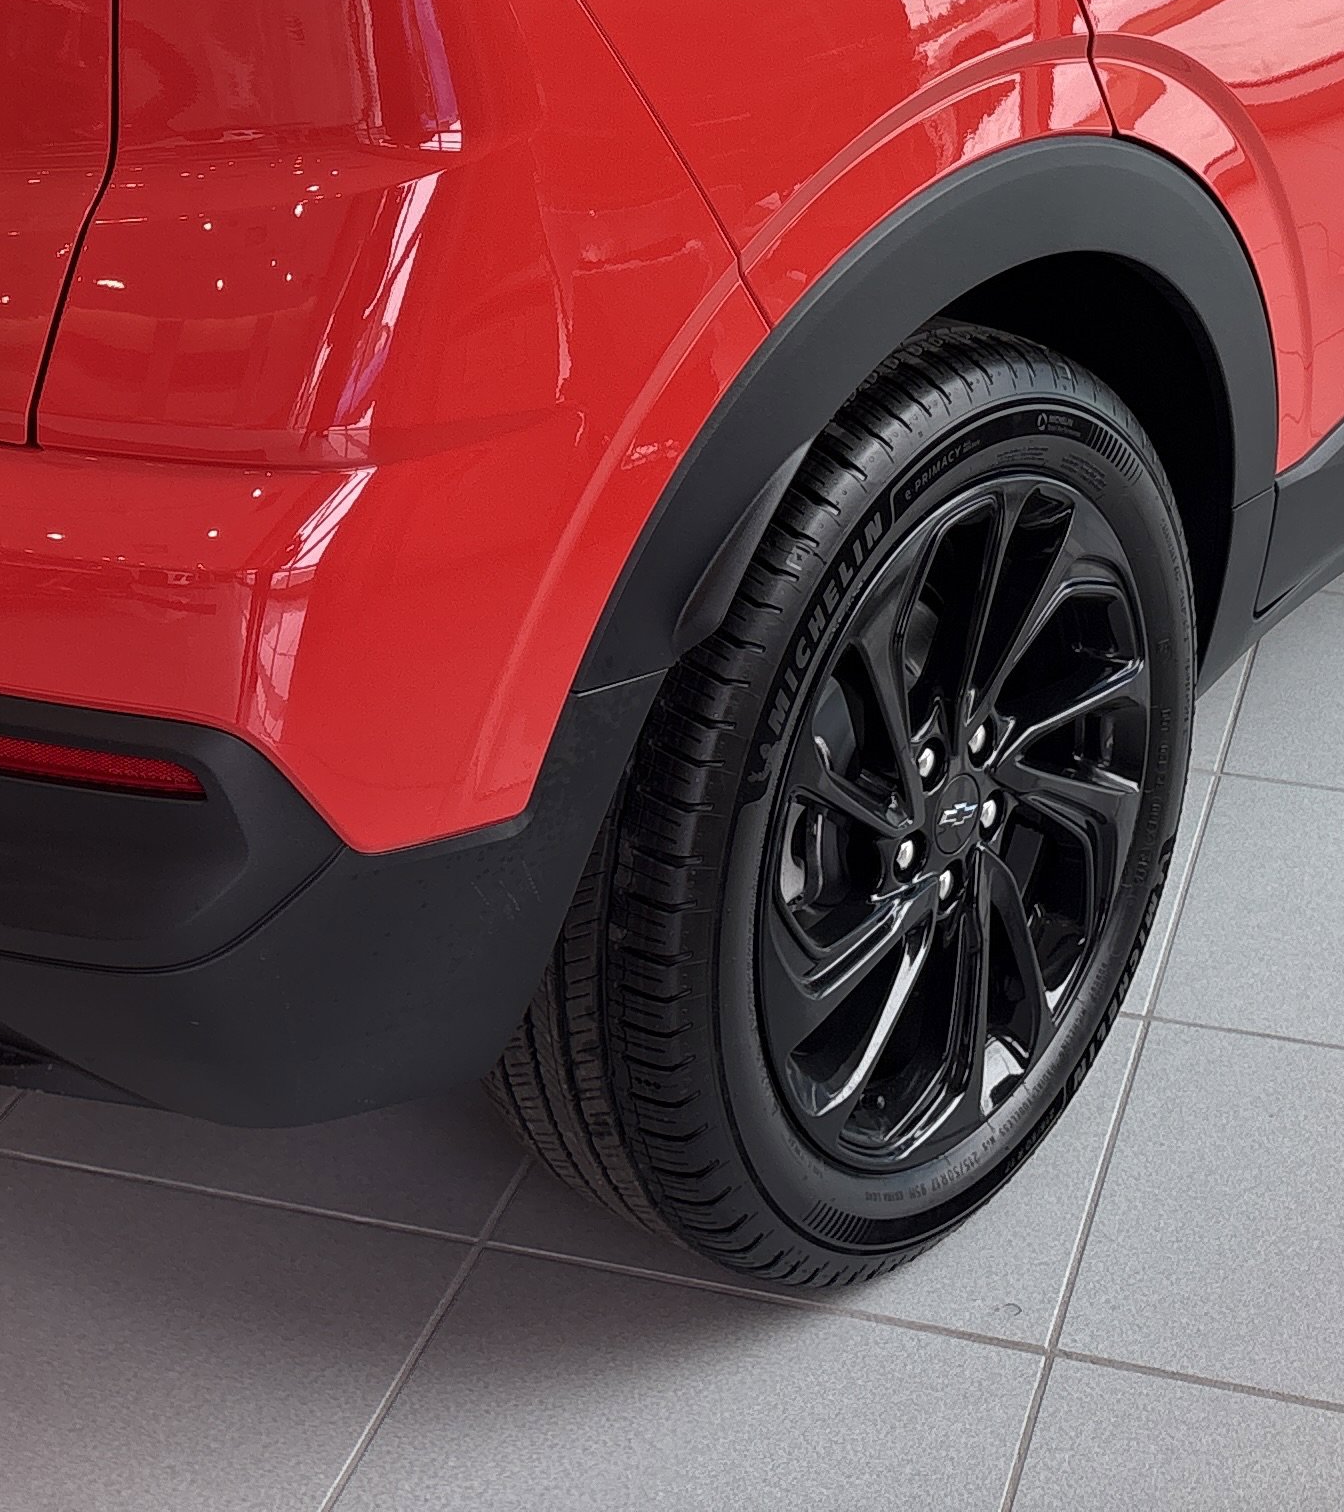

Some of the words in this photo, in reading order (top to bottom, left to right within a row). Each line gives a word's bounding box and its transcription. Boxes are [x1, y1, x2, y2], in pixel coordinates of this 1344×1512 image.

[914, 444, 962, 493] PRIMACY
[767, 511, 883, 737] MICHELIN
[1073, 890, 1158, 1090] MICHELIN
[930, 1150, 980, 1192] 215/50R17
